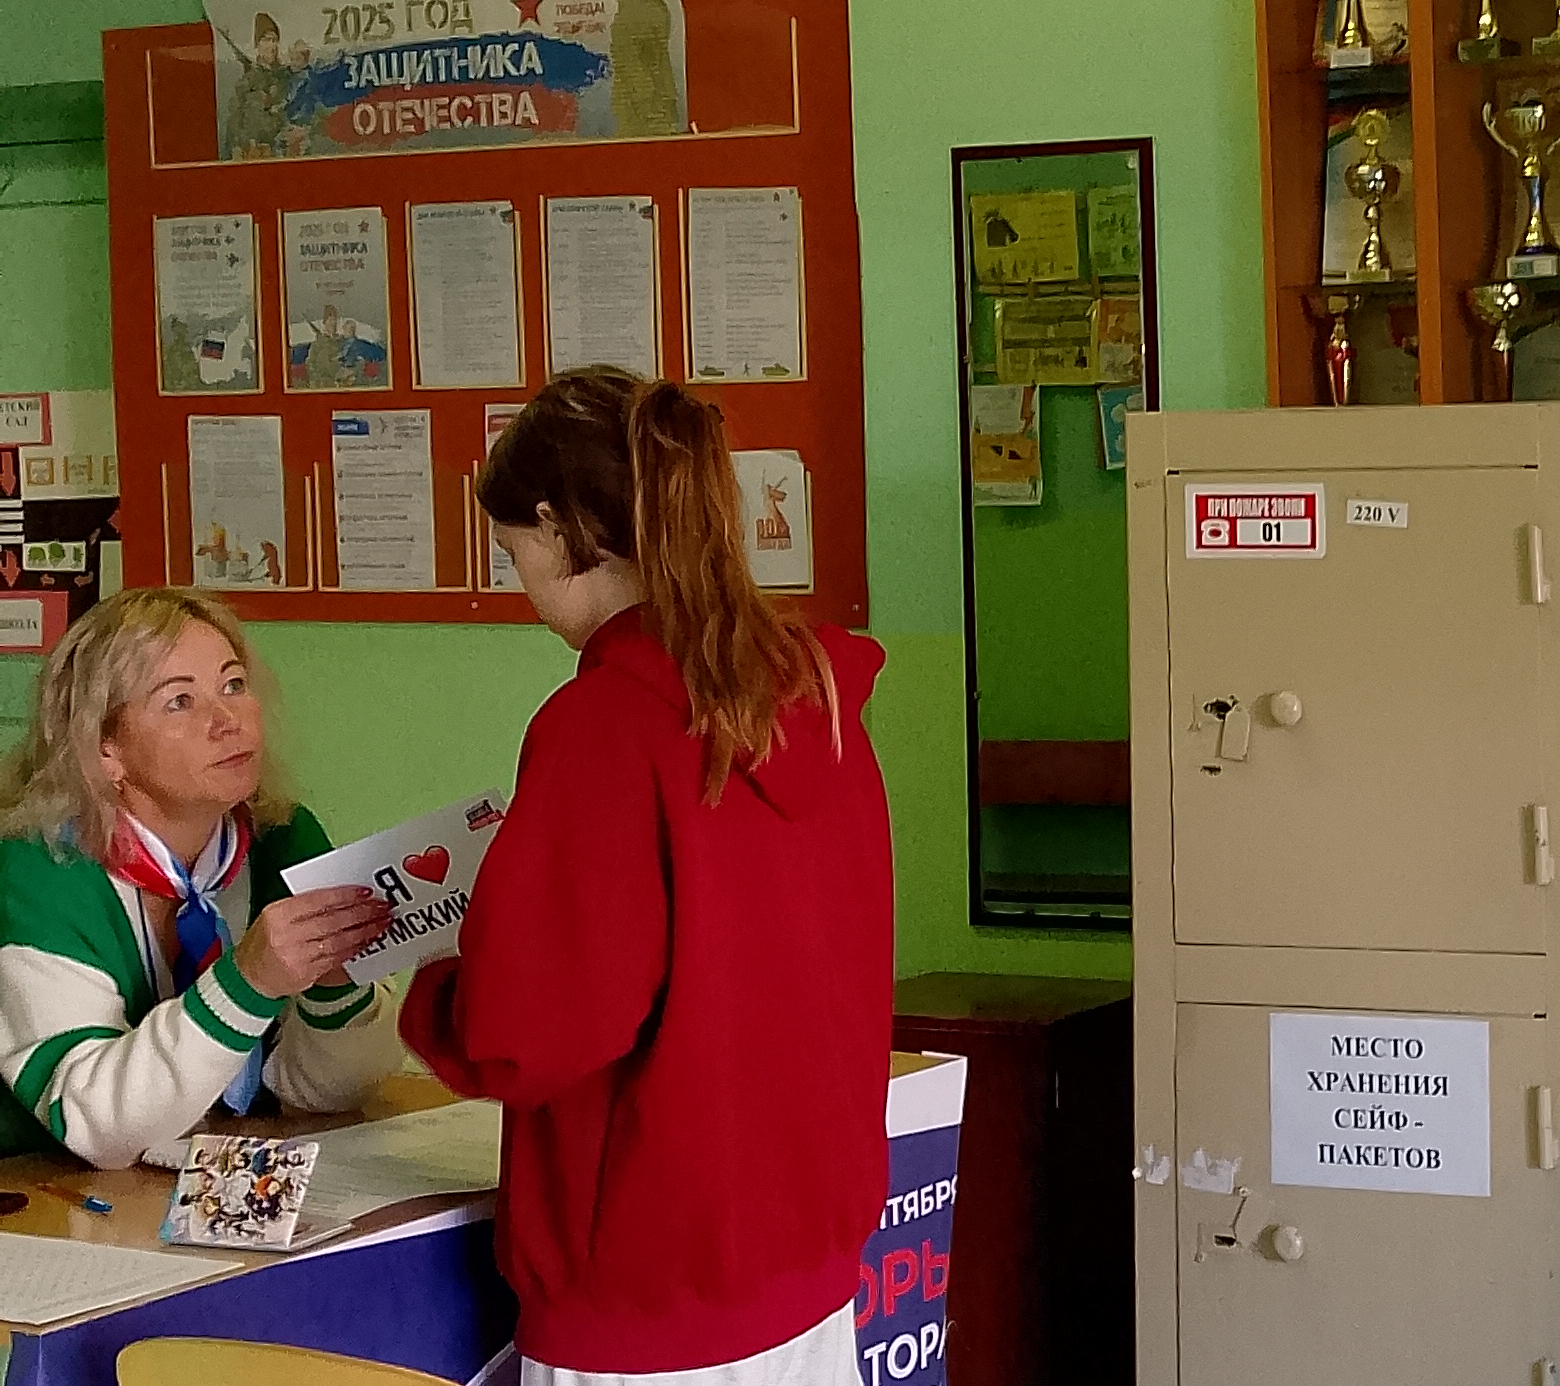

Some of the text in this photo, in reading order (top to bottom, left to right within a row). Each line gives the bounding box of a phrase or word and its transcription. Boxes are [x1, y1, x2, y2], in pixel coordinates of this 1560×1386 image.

[321, 2, 395, 44] 2025
[344, 40, 544, 91] ЗАЩИТНИКА
[352, 91, 540, 136] ОТЕЧЕСТВА
[1354, 505, 1401, 524] 220 V
[1262, 521, 1282, 543] 01
[373, 865, 414, 907] Я
[350, 887, 470, 963] РМСКИЙ
[1331, 1035, 1424, 1059] МЕСТО
[1307, 1071, 1448, 1097] ХРАНЕНИЯ
[1319, 1143, 1442, 1170] ПАКЕТОВ
